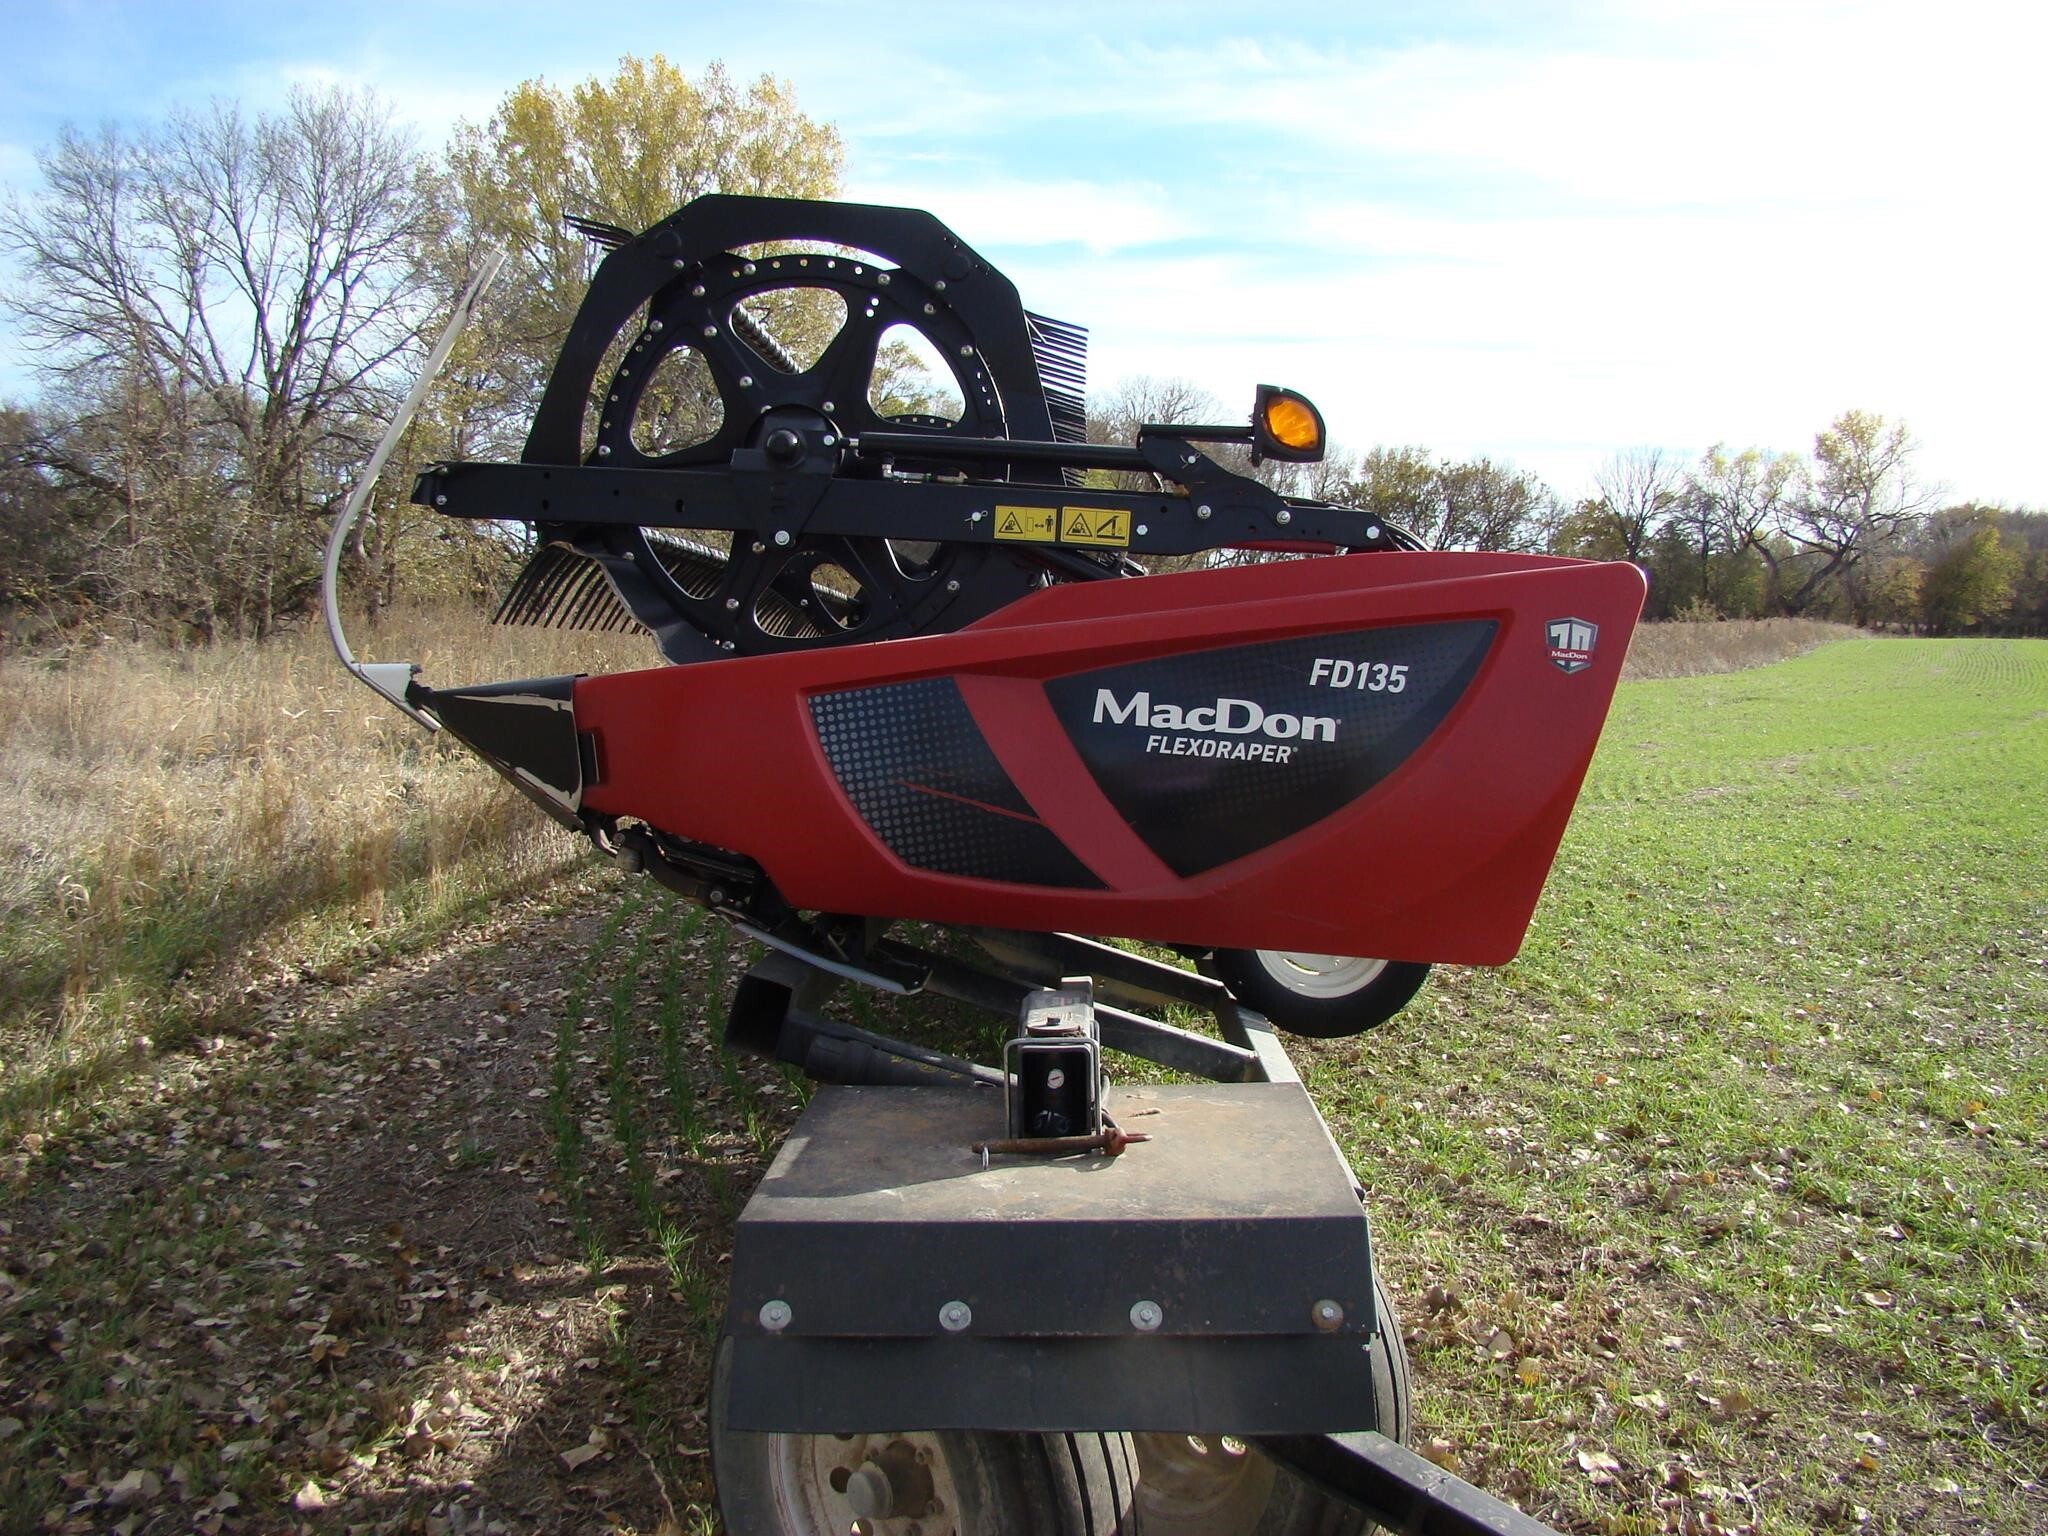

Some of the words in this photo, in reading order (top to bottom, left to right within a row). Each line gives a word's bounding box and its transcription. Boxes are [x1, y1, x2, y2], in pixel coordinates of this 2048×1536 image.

[1551, 650, 1588, 660] MacDon
[1309, 658, 1409, 693] FD135
[1093, 688, 1336, 742] MacDon
[1146, 735, 1291, 764] FLEXDRAPER
